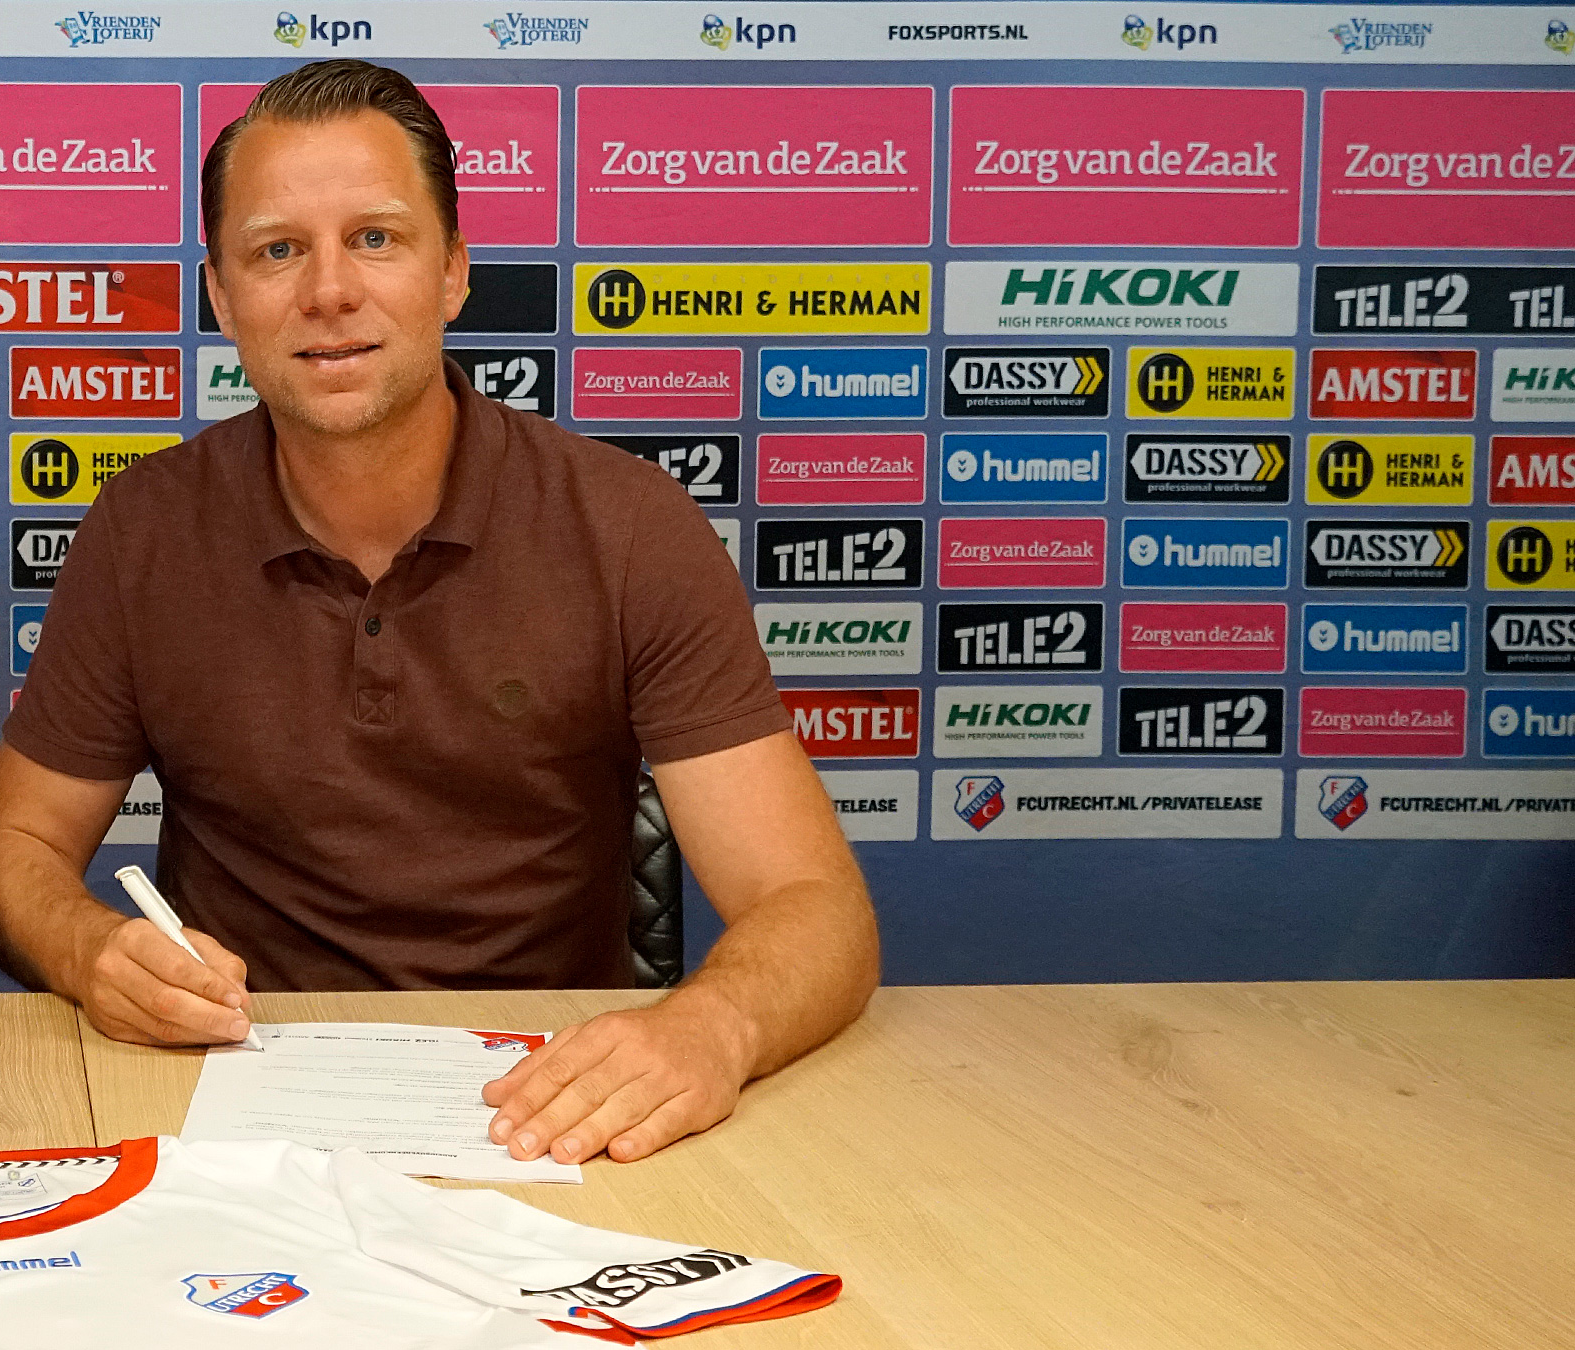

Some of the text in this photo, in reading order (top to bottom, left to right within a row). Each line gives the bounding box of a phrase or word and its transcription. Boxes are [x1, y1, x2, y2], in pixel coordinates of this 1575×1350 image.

[77, 11, 161, 28] VRIENDEN
[311, 15, 371, 46] kpn
[507, 12, 589, 29] VRIENDEN
[736, 17, 795, 49] kpn
[889, 25, 1028, 40] FOXSPORTS.NL
[1350, 18, 1432, 36] VRIENDEN
[91, 27, 154, 44] LOTERIJ
[520, 28, 582, 46] LOTERIJ
[1157, 18, 1216, 50] kpn
[1363, 34, 1426, 51] LOTERIJ
[13, 138, 56, 172] de
[62, 138, 156, 172] Zaak
[602, 140, 907, 184] Zorg van de Zaak
[975, 141, 1277, 183] Zorg van de Zaak
[1345, 144, 1430, 187] Zorg
[1434, 153, 1503, 178] van
[1509, 144, 1552, 178] de
[653, 290, 919, 316] HENRI & HERMAN
[1335, 273, 1469, 327] TELE2
[999, 317, 1227, 329] HIGH PERFORMANCE POWER TOOLS
[584, 371, 730, 392] Zorg van de Zaak
[802, 365, 919, 397] hummel
[965, 362, 1067, 389] DASSY
[1208, 367, 1285, 383] HENRI &
[967, 397, 1085, 408] professional workwear
[1207, 385, 1284, 401] HERMAN
[983, 450, 1099, 481] hummel
[1146, 443, 1251, 476] DASSY
[773, 528, 905, 581] TELE2
[793, 707, 912, 740] MSTEL
[206, 1275, 287, 1312] UTRECHT
[208, 1279, 227, 1290] F
[565, 1261, 702, 1307] ASSY
[258, 1293, 287, 1305] C
